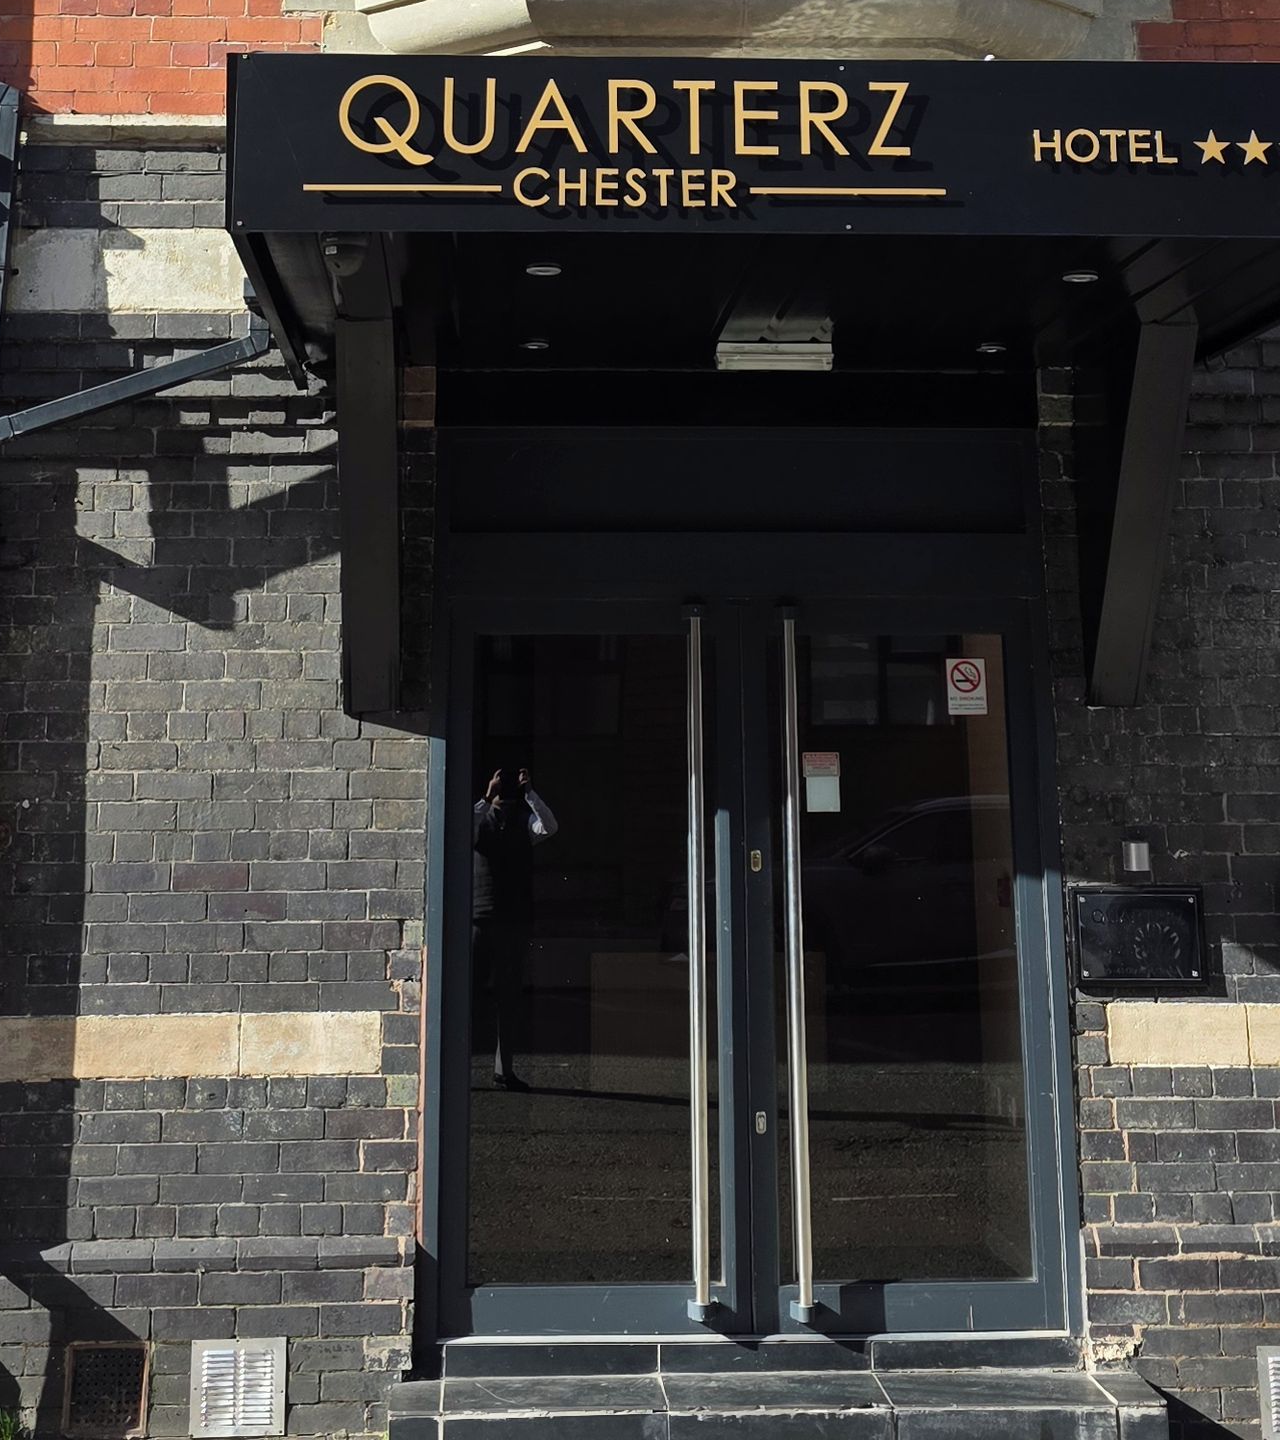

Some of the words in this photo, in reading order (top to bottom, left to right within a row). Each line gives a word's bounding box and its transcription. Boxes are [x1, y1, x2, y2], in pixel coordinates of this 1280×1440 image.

[338, 75, 911, 166] QUARTERZ
[1032, 128, 1177, 165] HOTEL
[512, 167, 738, 208] CHESTER
